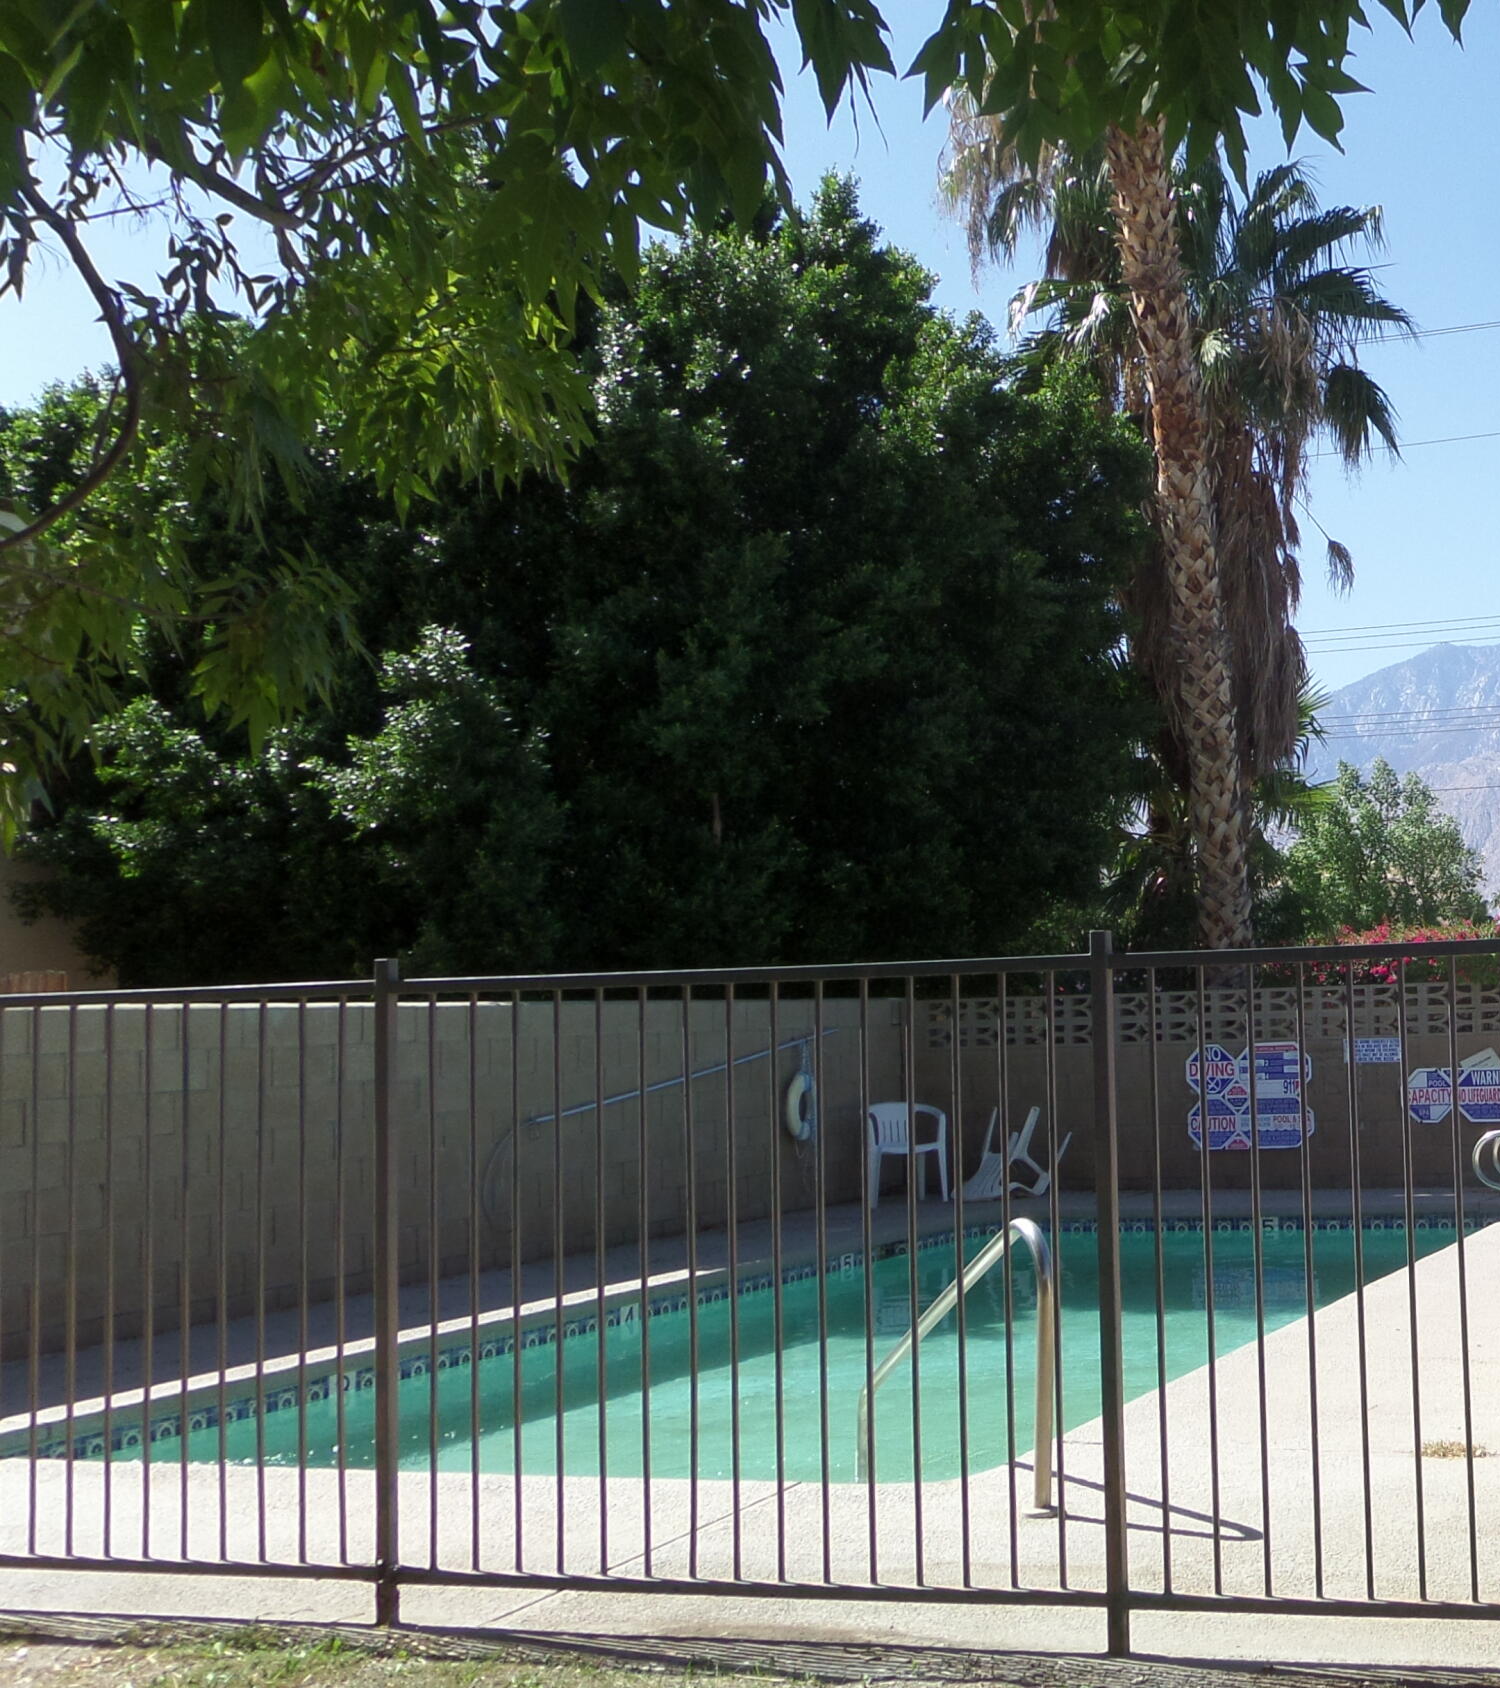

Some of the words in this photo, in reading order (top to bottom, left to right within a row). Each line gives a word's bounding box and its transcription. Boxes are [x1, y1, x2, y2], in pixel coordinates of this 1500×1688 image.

[1204, 1047, 1221, 1061] NO
[1189, 1063, 1235, 1077] DVING
[1190, 1117, 1236, 1131] CUTION
